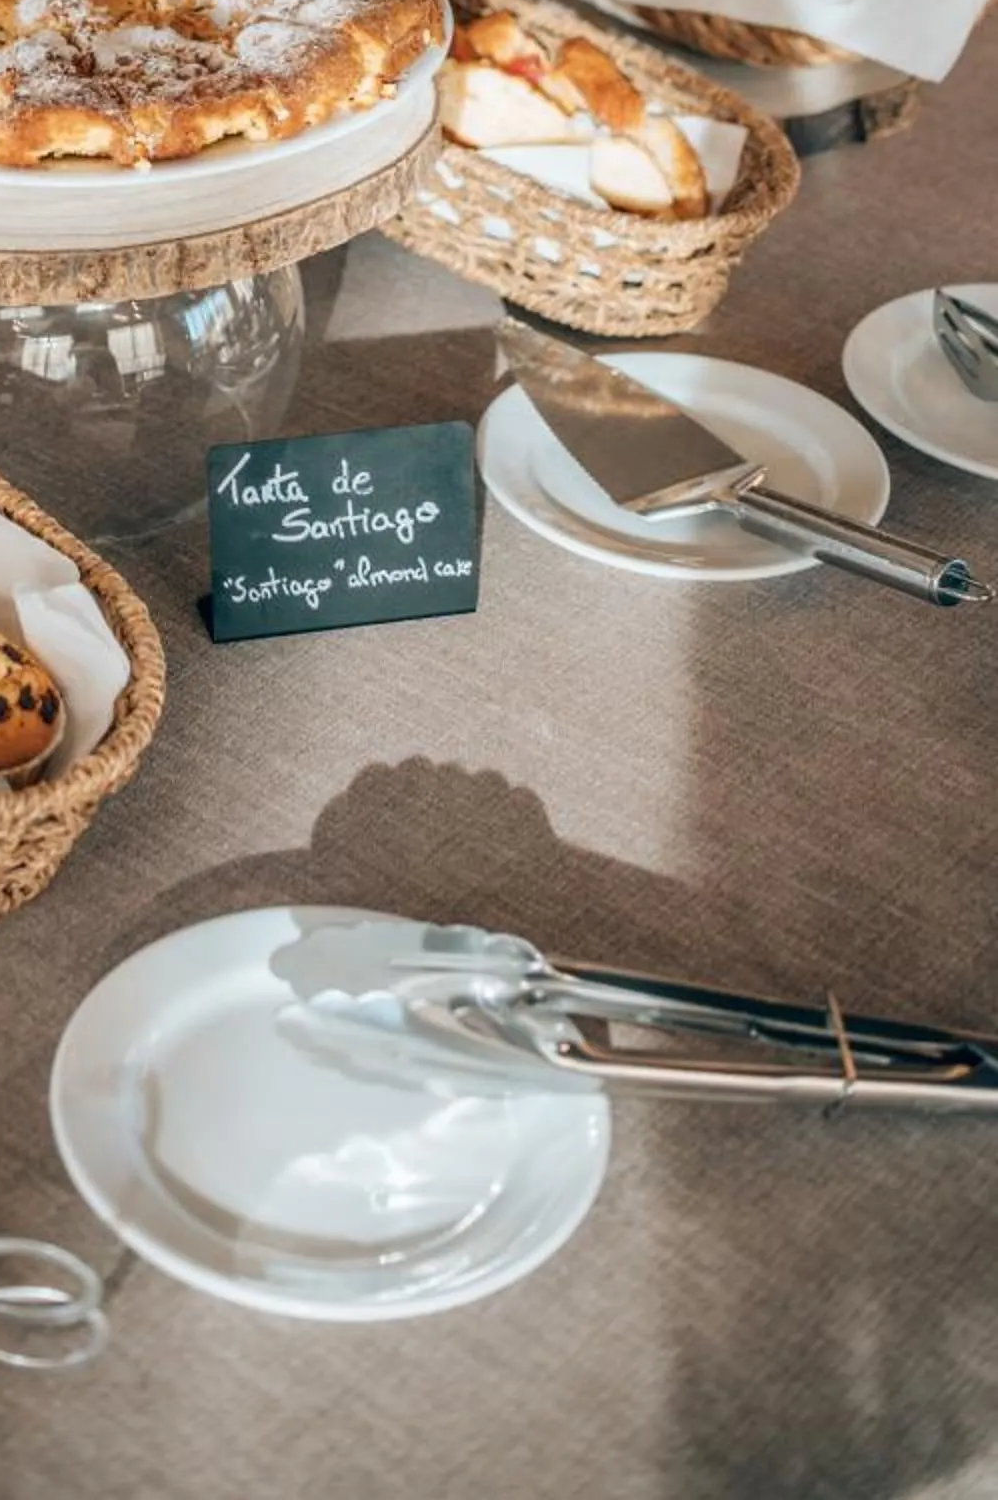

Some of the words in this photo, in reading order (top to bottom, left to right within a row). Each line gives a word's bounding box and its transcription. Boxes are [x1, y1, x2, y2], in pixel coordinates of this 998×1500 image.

[217, 452, 309, 505] Tarta
[332, 458, 374, 495] de
[272, 499, 440, 544] Santiago
[348, 555, 429, 588] almond
[434, 558, 472, 578] cake
